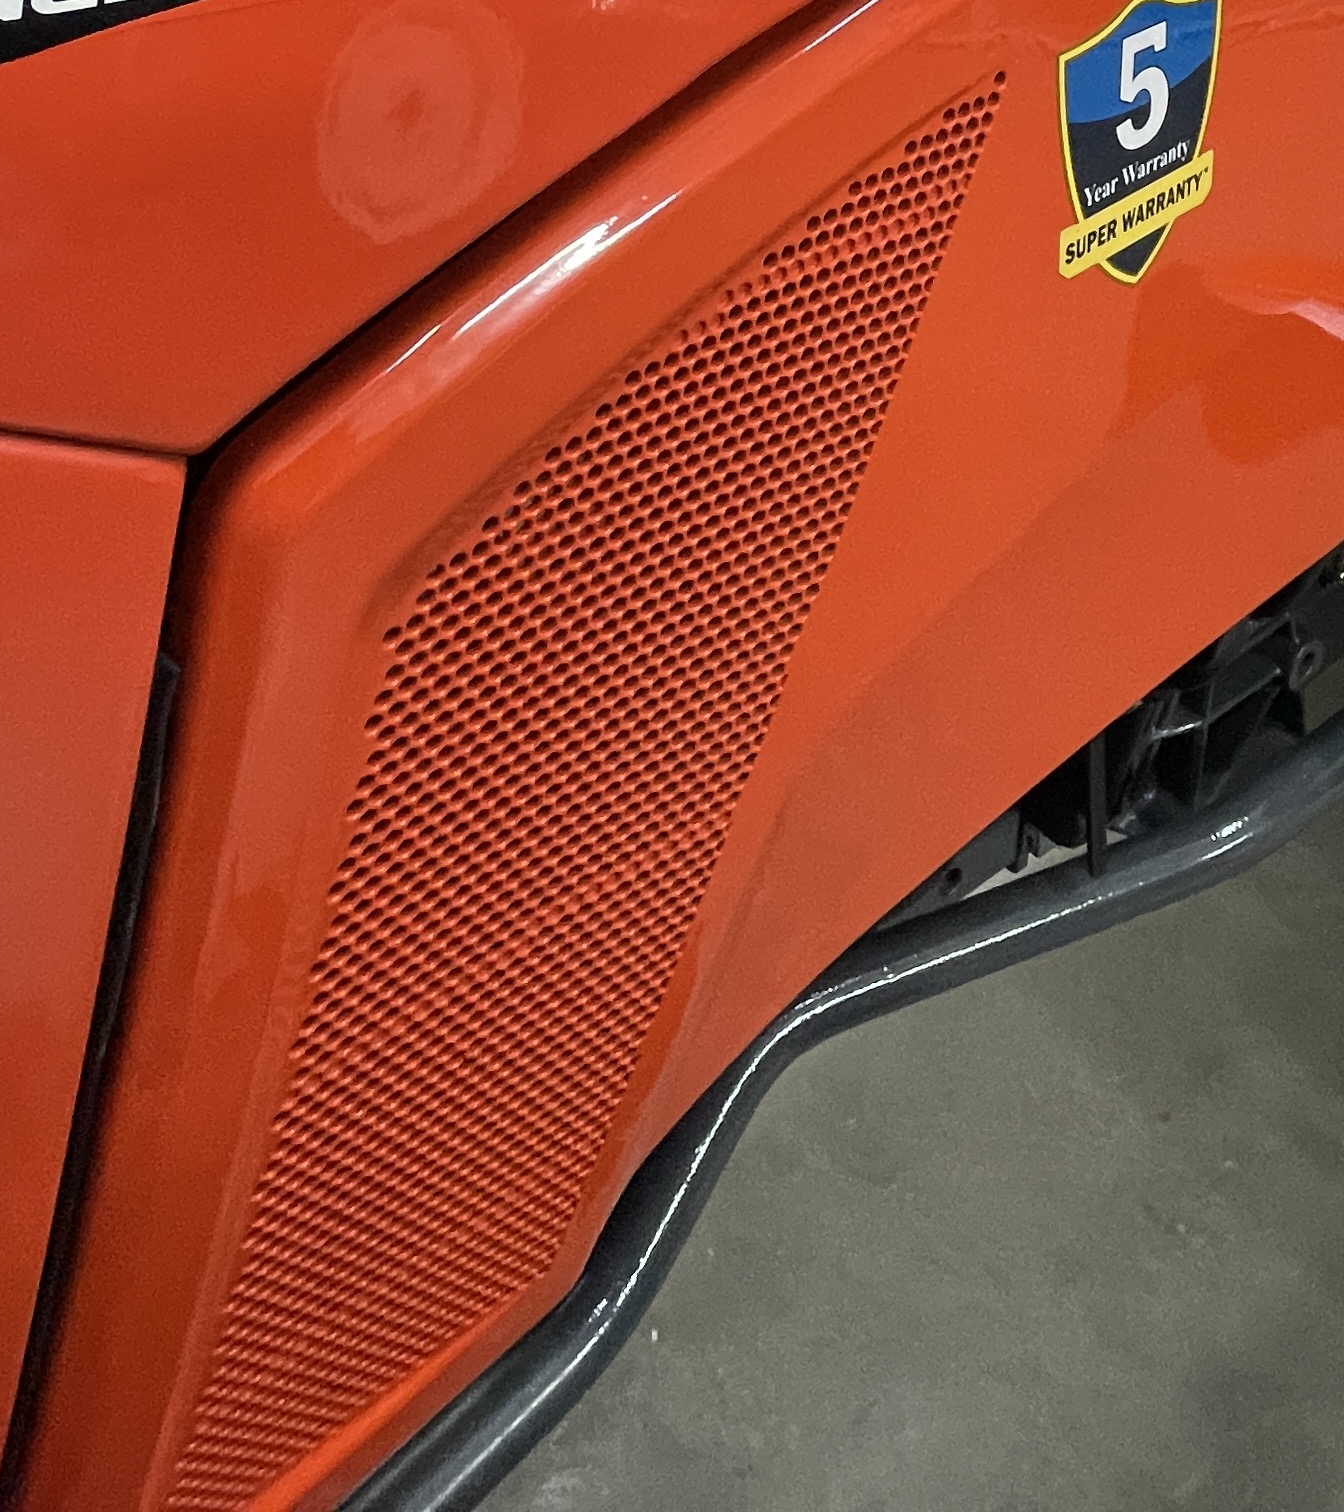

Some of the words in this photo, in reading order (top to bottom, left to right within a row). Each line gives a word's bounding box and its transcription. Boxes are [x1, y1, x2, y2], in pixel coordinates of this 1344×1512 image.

[1116, 20, 1170, 151] 5
[1064, 218, 1117, 265] SUPER
[1122, 173, 1203, 233] WARRANTY
[1083, 178, 1119, 208] Year
[1122, 138, 1191, 187] Warranty
